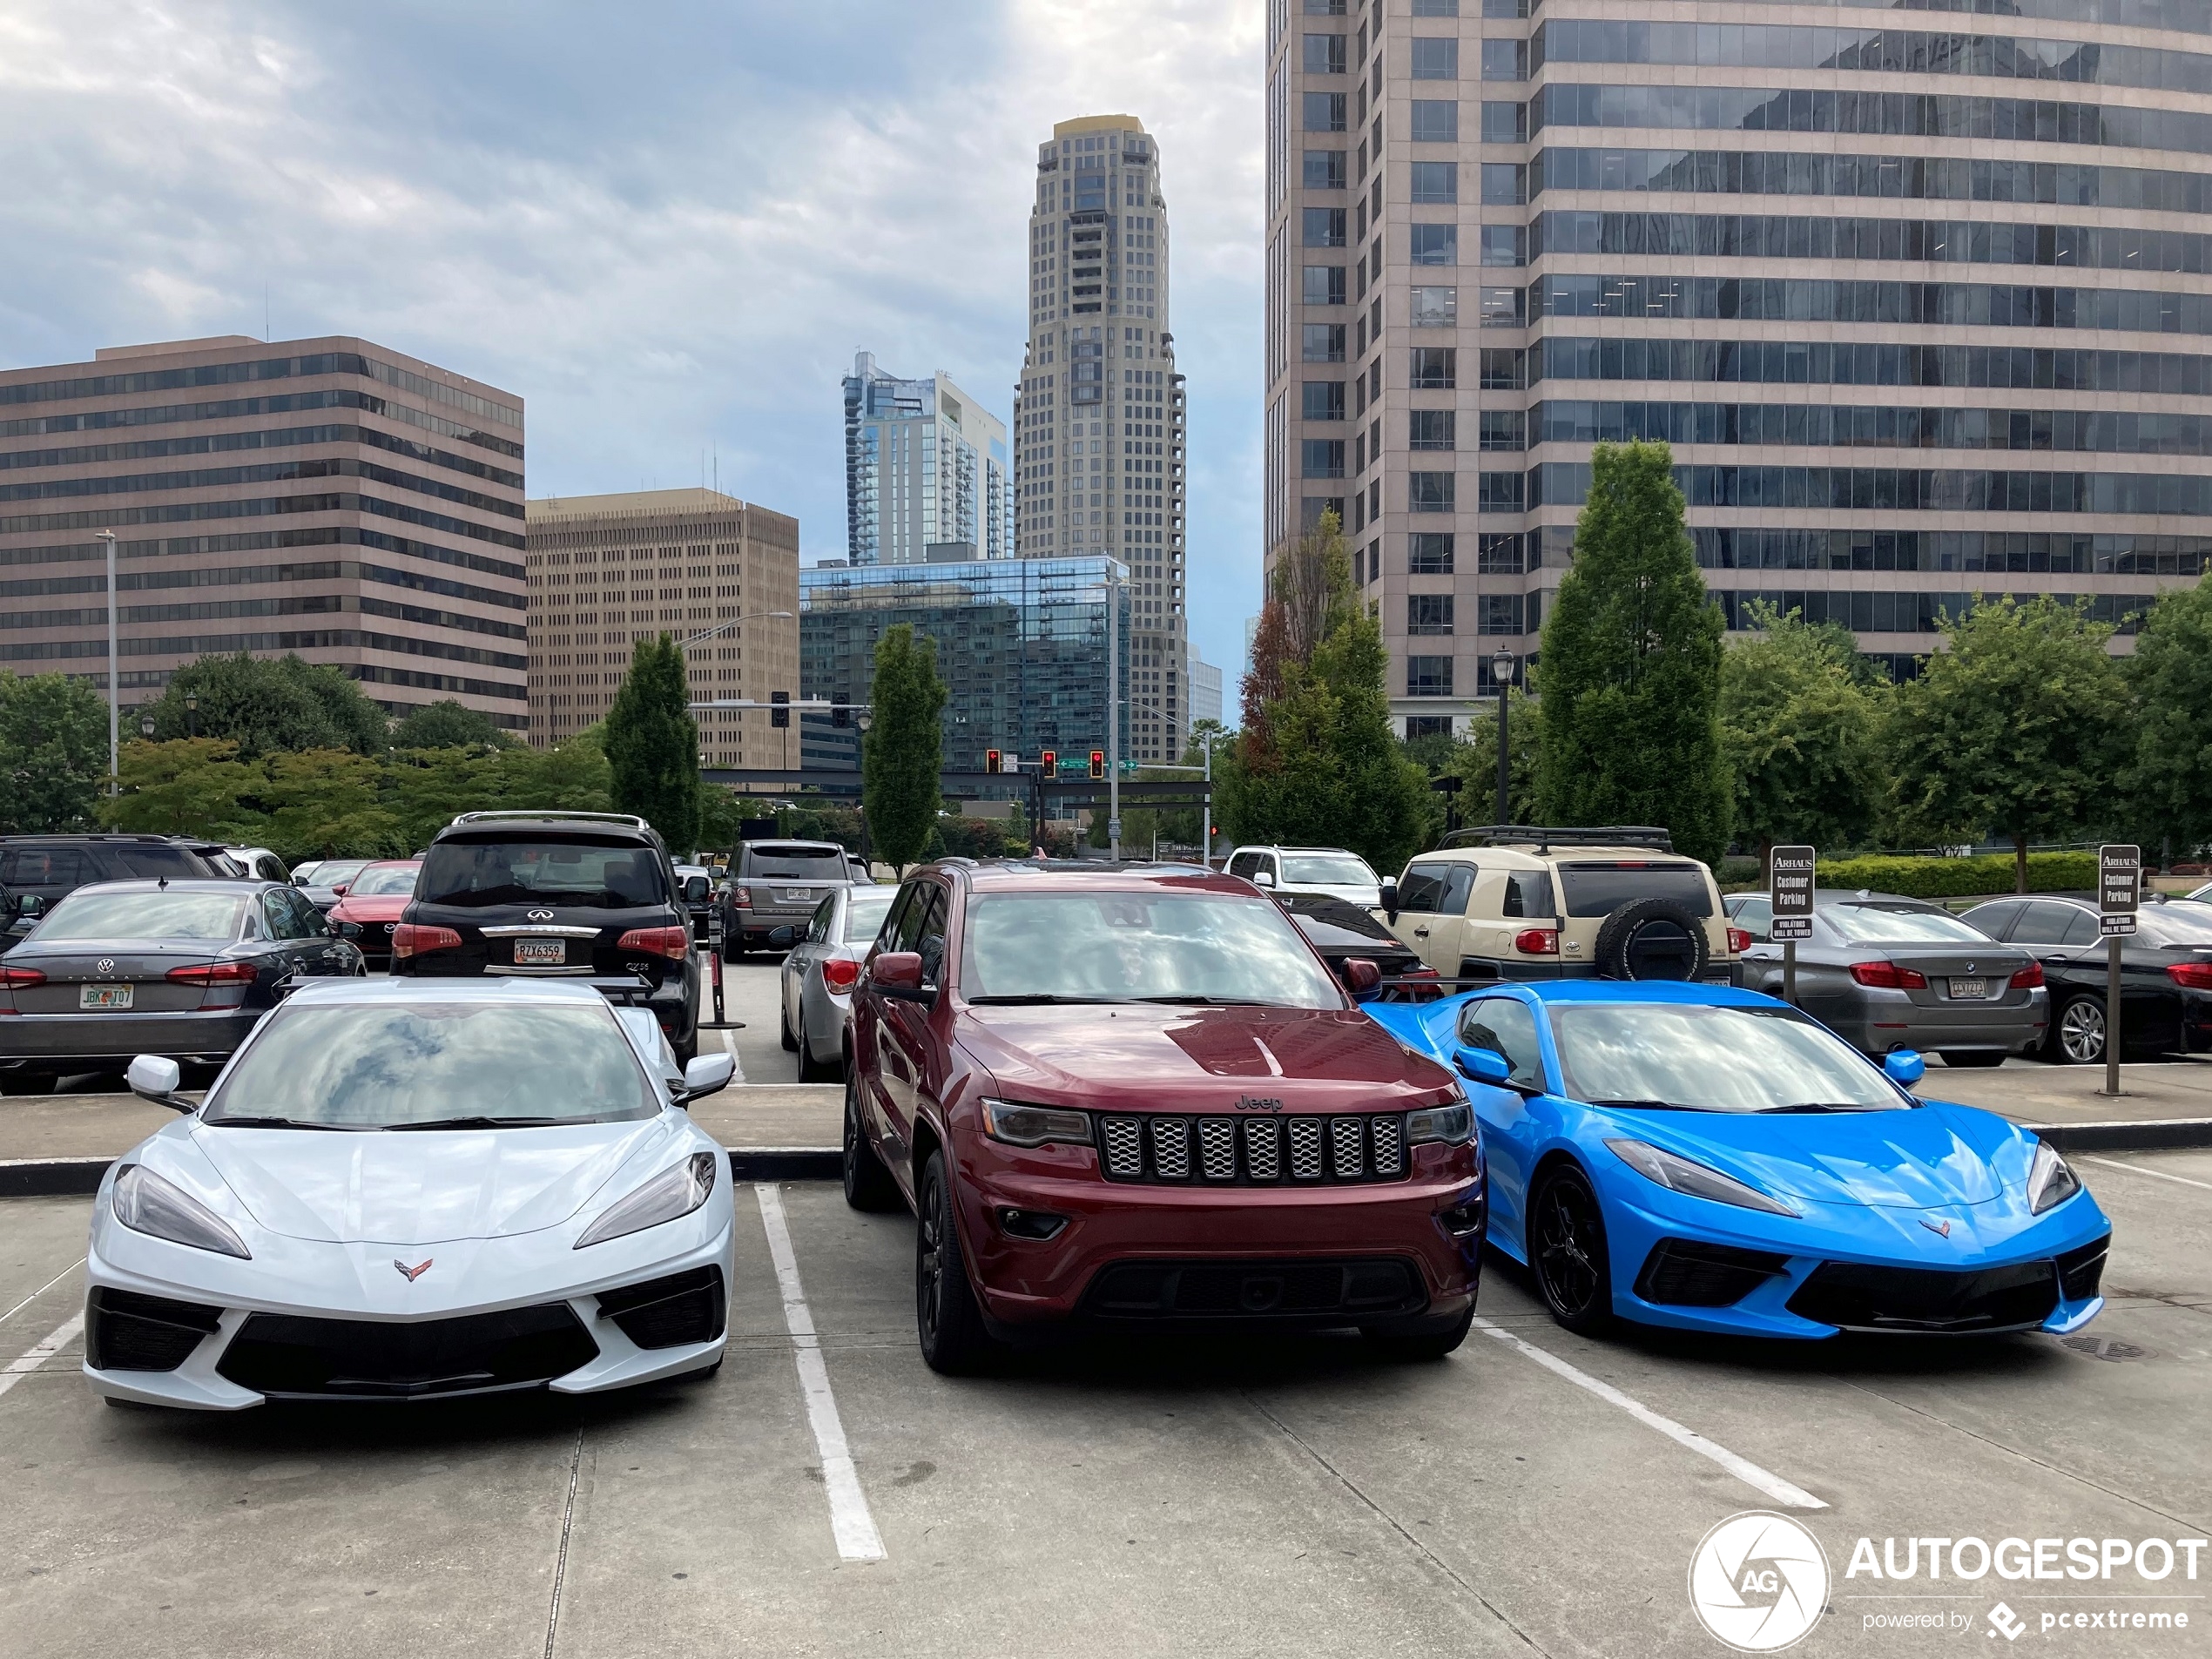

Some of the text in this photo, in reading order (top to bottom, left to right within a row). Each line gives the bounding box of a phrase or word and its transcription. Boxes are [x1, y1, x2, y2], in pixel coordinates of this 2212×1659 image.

[1774, 857, 1812, 867] ARHAUS
[2102, 856, 2137, 866] ARHAUS
[1777, 876, 1808, 888] Customer
[2105, 873, 2134, 886] Customer
[1779, 893, 1806, 906] Parking
[2107, 890, 2131, 903] Parking
[1786, 928, 1793, 937] BE
[520, 945, 560, 957] RZX6359
[1684, 929, 1700, 982] BFGoodric
[84, 990, 101, 1002] JBK
[1235, 1095, 1284, 1112] Jeep
